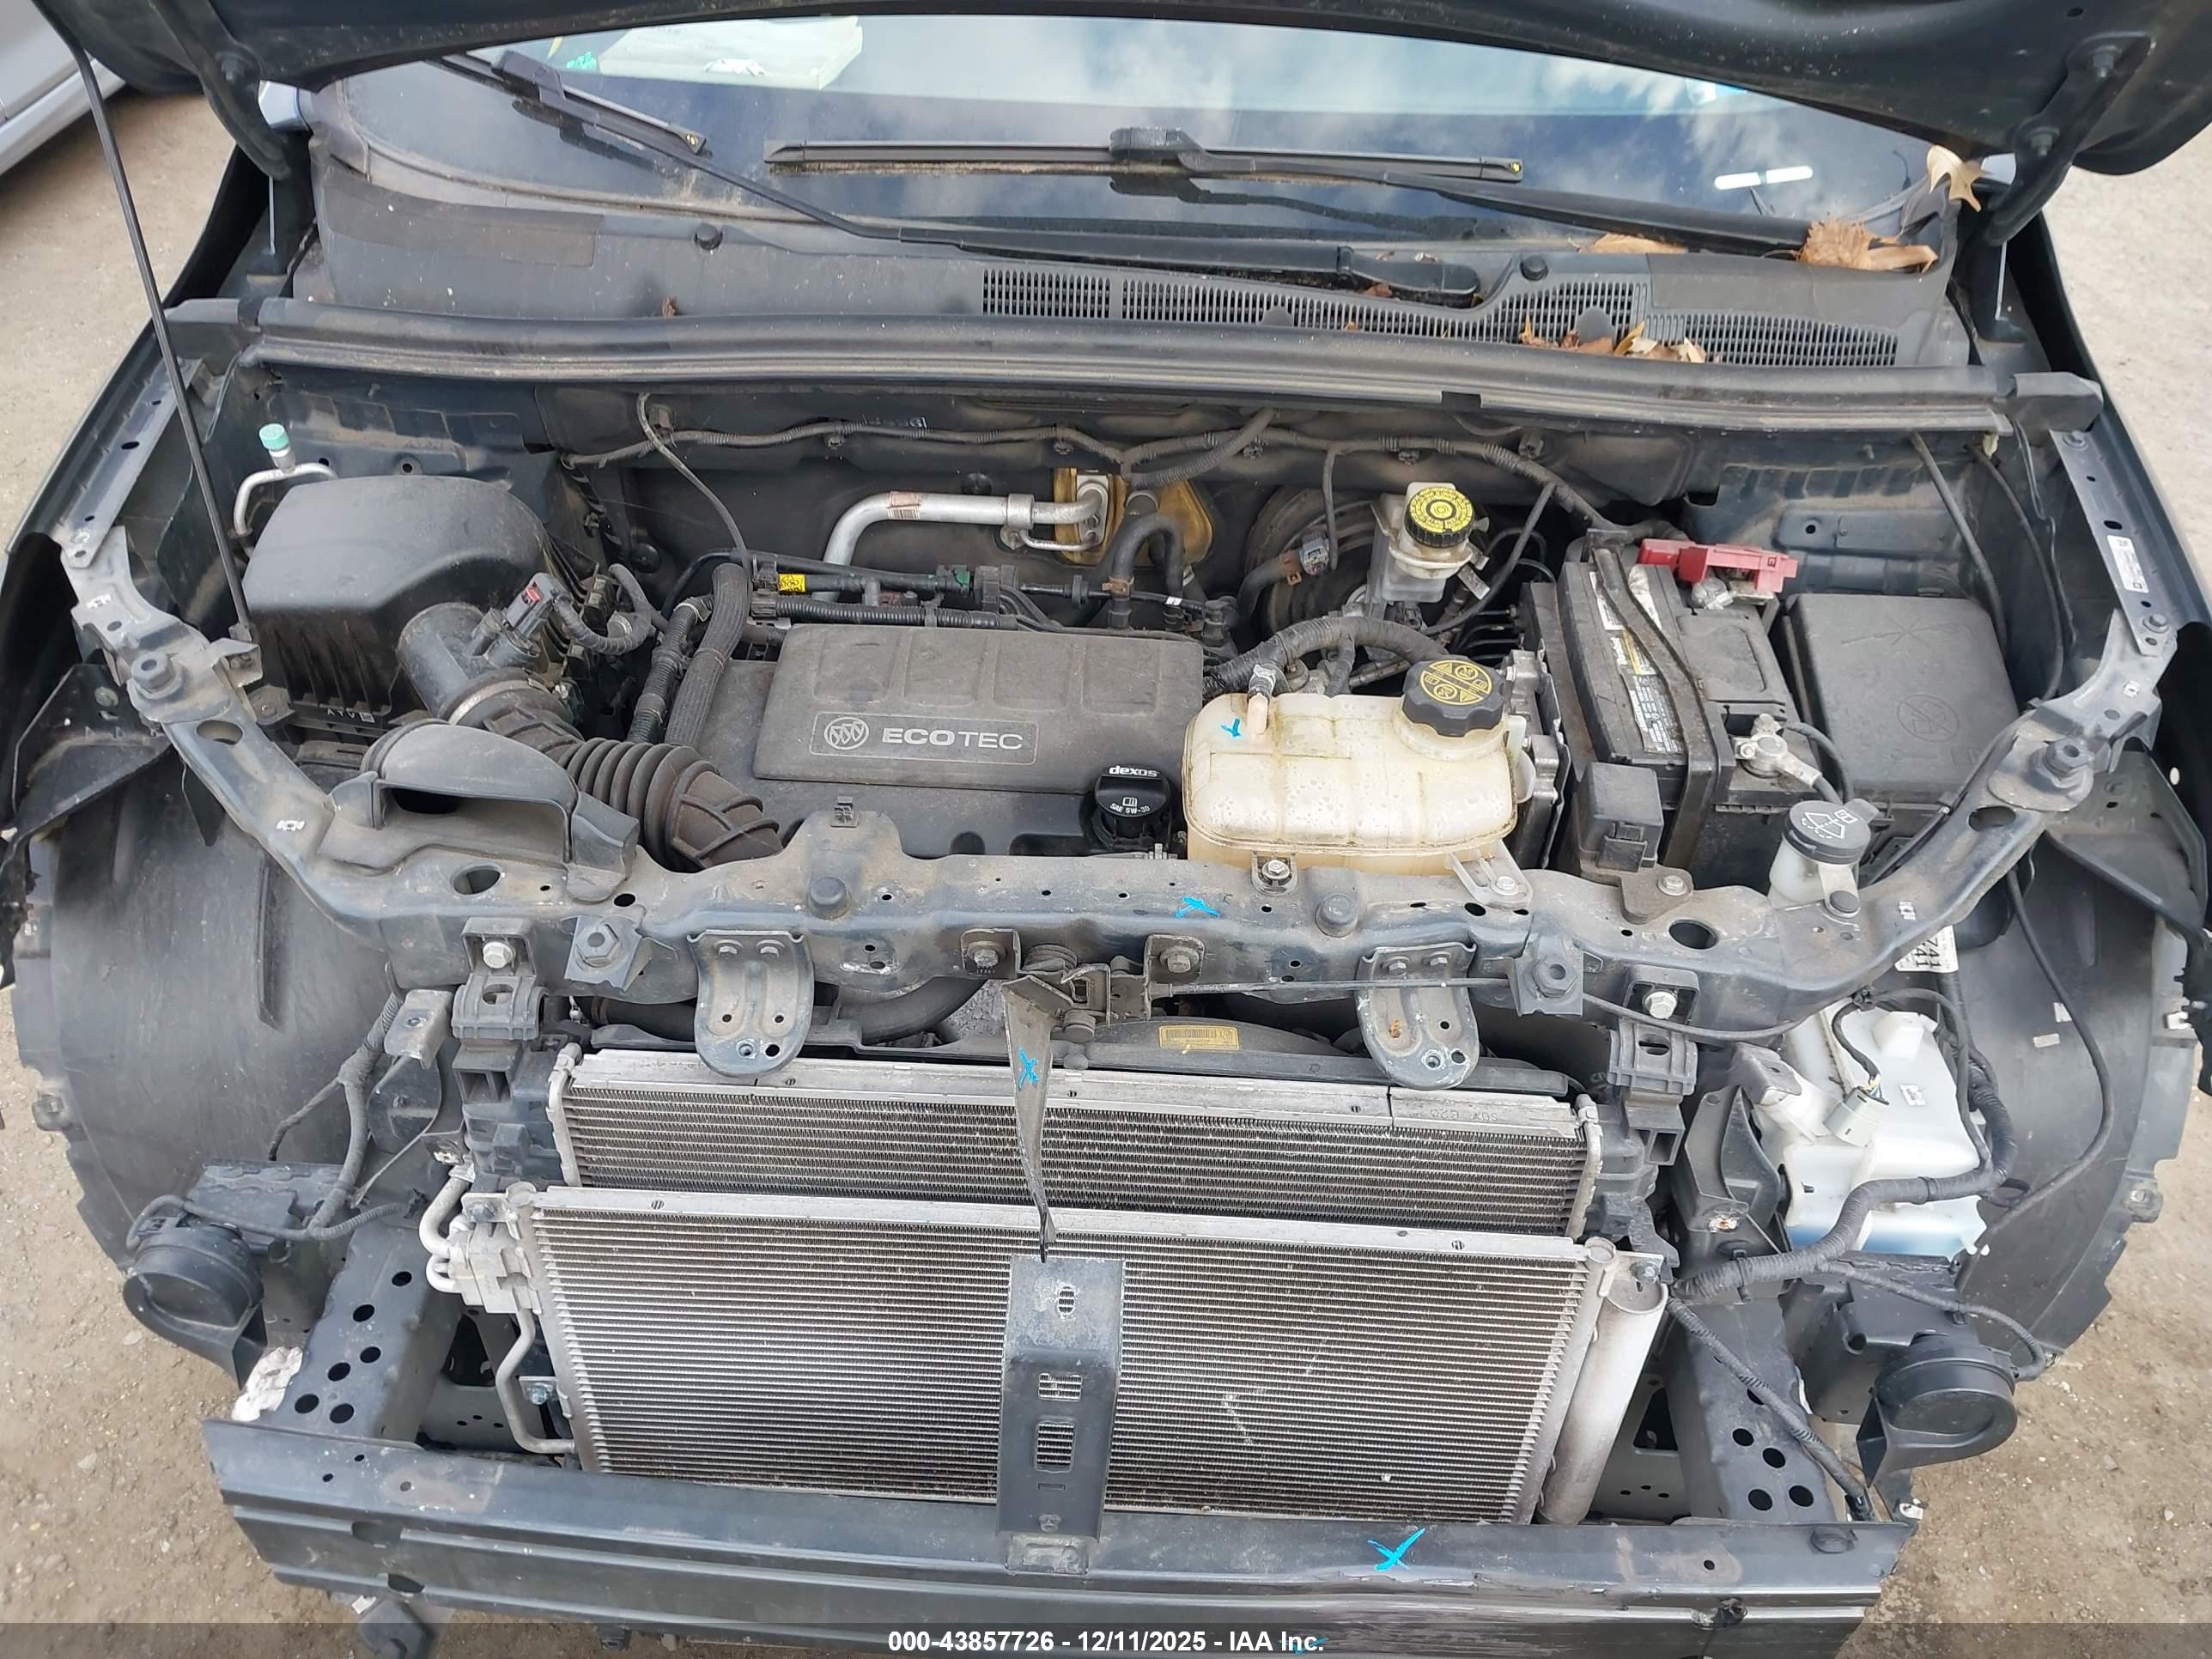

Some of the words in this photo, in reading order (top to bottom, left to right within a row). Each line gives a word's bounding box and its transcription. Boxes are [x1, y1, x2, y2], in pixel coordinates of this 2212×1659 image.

[882, 727, 1024, 750] ECOTEC
[1109, 765, 1160, 777] dexos
[1109, 802, 1124, 813] SAE
[1125, 805, 1151, 815] 5W-30
